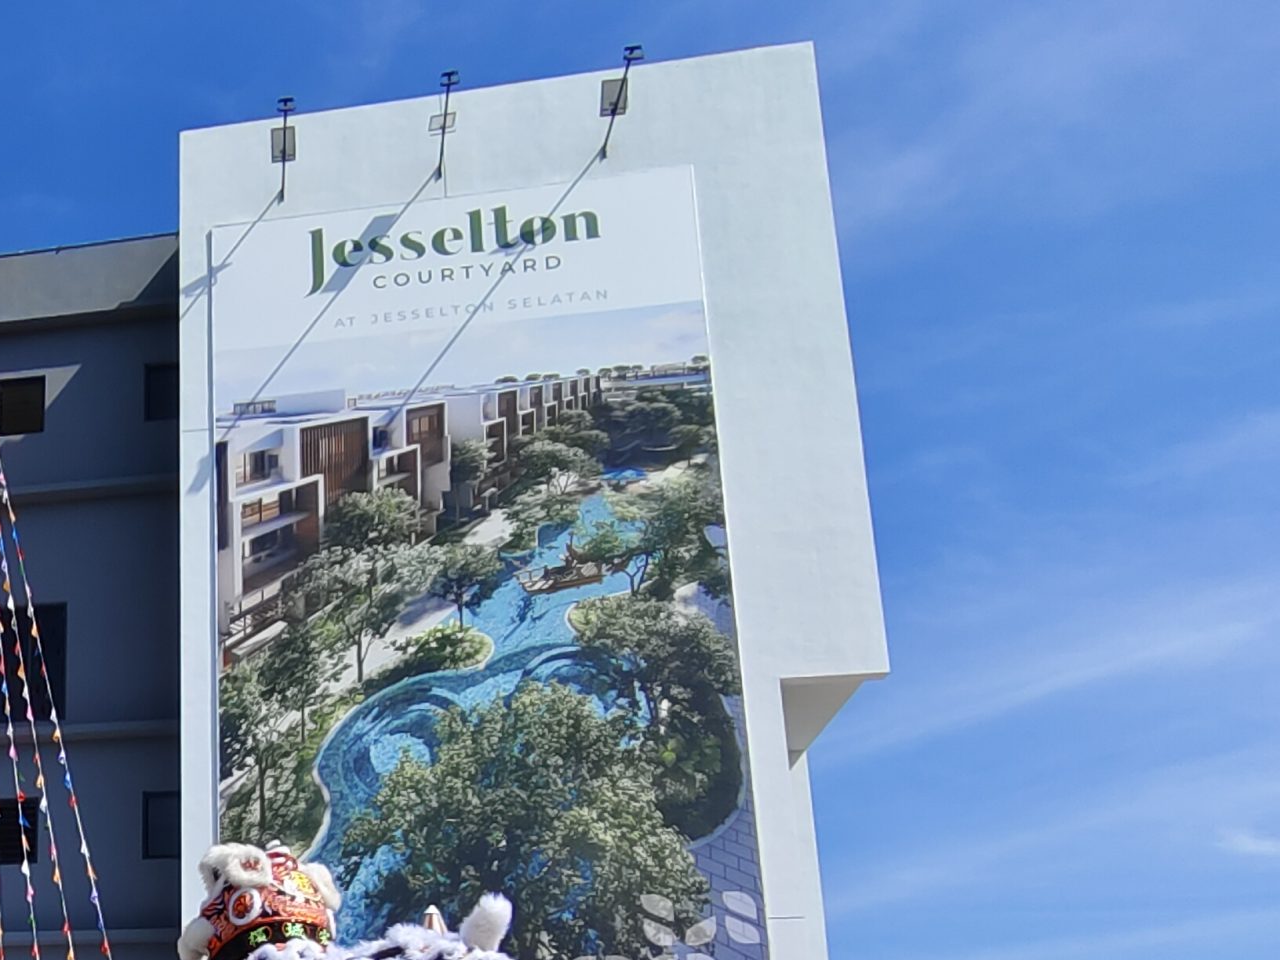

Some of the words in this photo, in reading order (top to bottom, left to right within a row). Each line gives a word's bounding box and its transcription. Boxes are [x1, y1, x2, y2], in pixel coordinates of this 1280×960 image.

[304, 205, 602, 298] Jesselton
[372, 254, 562, 289] COURTYARD
[334, 315, 357, 329] AT
[371, 301, 495, 325] JESSELTON
[506, 289, 609, 310] SELATAN
